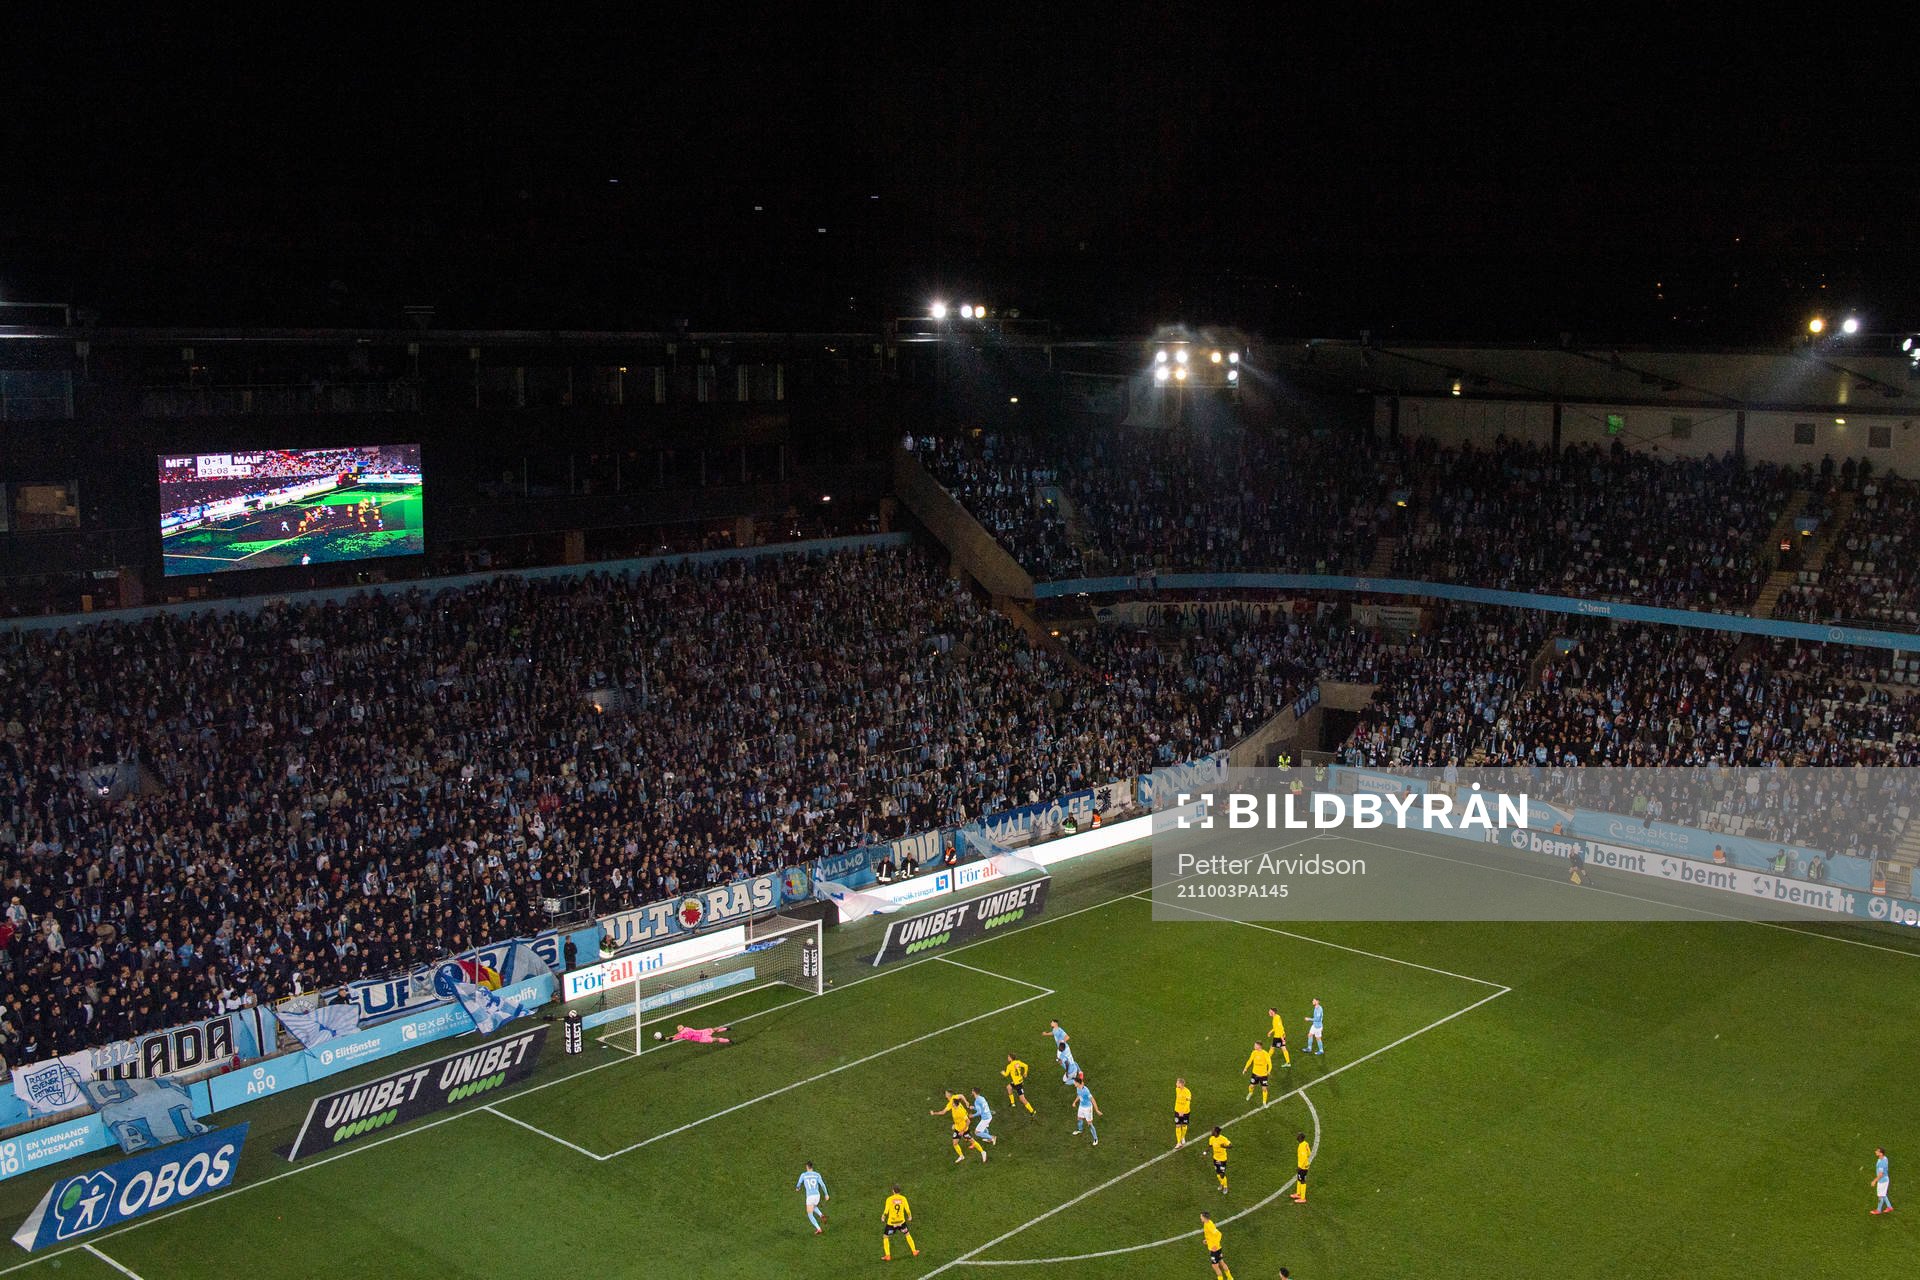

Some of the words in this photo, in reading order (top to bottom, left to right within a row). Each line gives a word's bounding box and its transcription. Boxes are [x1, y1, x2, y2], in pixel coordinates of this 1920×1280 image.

[165, 458, 192, 468] MFF
[204, 457, 223, 466] 0-1
[233, 455, 265, 465] MAIF
[200, 467, 228, 476] 93:08
[1588, 603, 1611, 615] bemt
[985, 799, 1063, 842] MALMÖ
[1626, 825, 1689, 844] exakta
[1593, 844, 1646, 873] bemt
[959, 868, 981, 885] För
[1680, 860, 1737, 890] bemt
[1775, 873, 1834, 909] bemt
[899, 904, 969, 945] UNIBET
[977, 883, 1042, 921] UNIBET
[1890, 900, 1920, 927] be
[572, 969, 605, 994] För
[610, 961, 634, 983] all
[638, 952, 664, 973] tid
[335, 1038, 381, 1059] Elitfönster
[573, 1022, 582, 1053] SELECT
[94, 1039, 135, 1066] 1312
[247, 1075, 276, 1095] ApQ
[324, 1069, 431, 1128] UNIBET
[438, 1035, 535, 1090] UNIBET
[26, 1141, 40, 1151] EN
[41, 1125, 90, 1146] VINNANDE
[27, 1137, 86, 1161] MÖTESPLATS
[1, 1157, 19, 1176] 10
[118, 1143, 235, 1216] OBOS
[895, 1203, 901, 1215] 9
